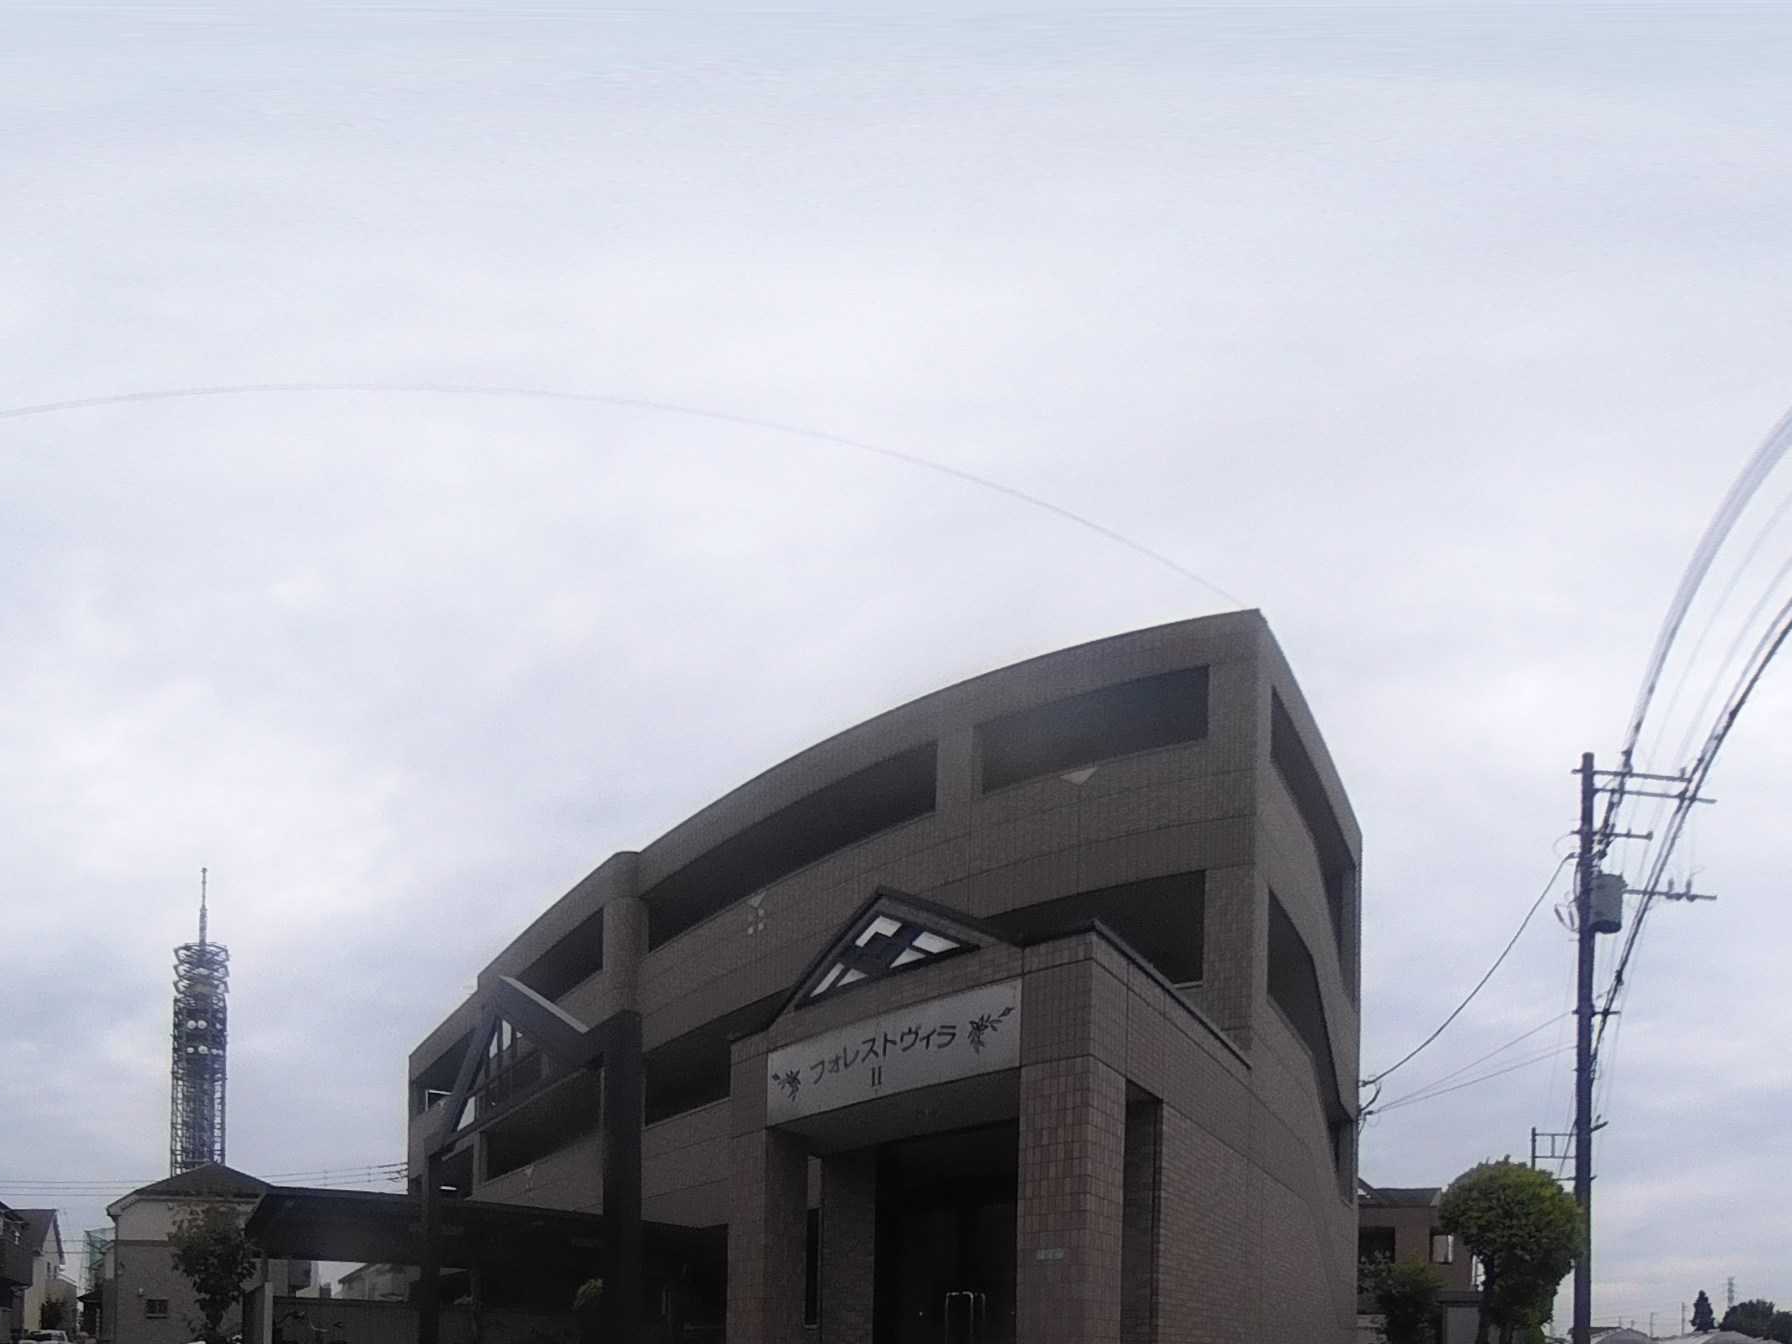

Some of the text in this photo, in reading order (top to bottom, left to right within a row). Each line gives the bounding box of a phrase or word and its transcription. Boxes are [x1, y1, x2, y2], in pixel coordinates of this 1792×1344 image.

[809, 1024, 958, 1085] フォレストヴィラ
